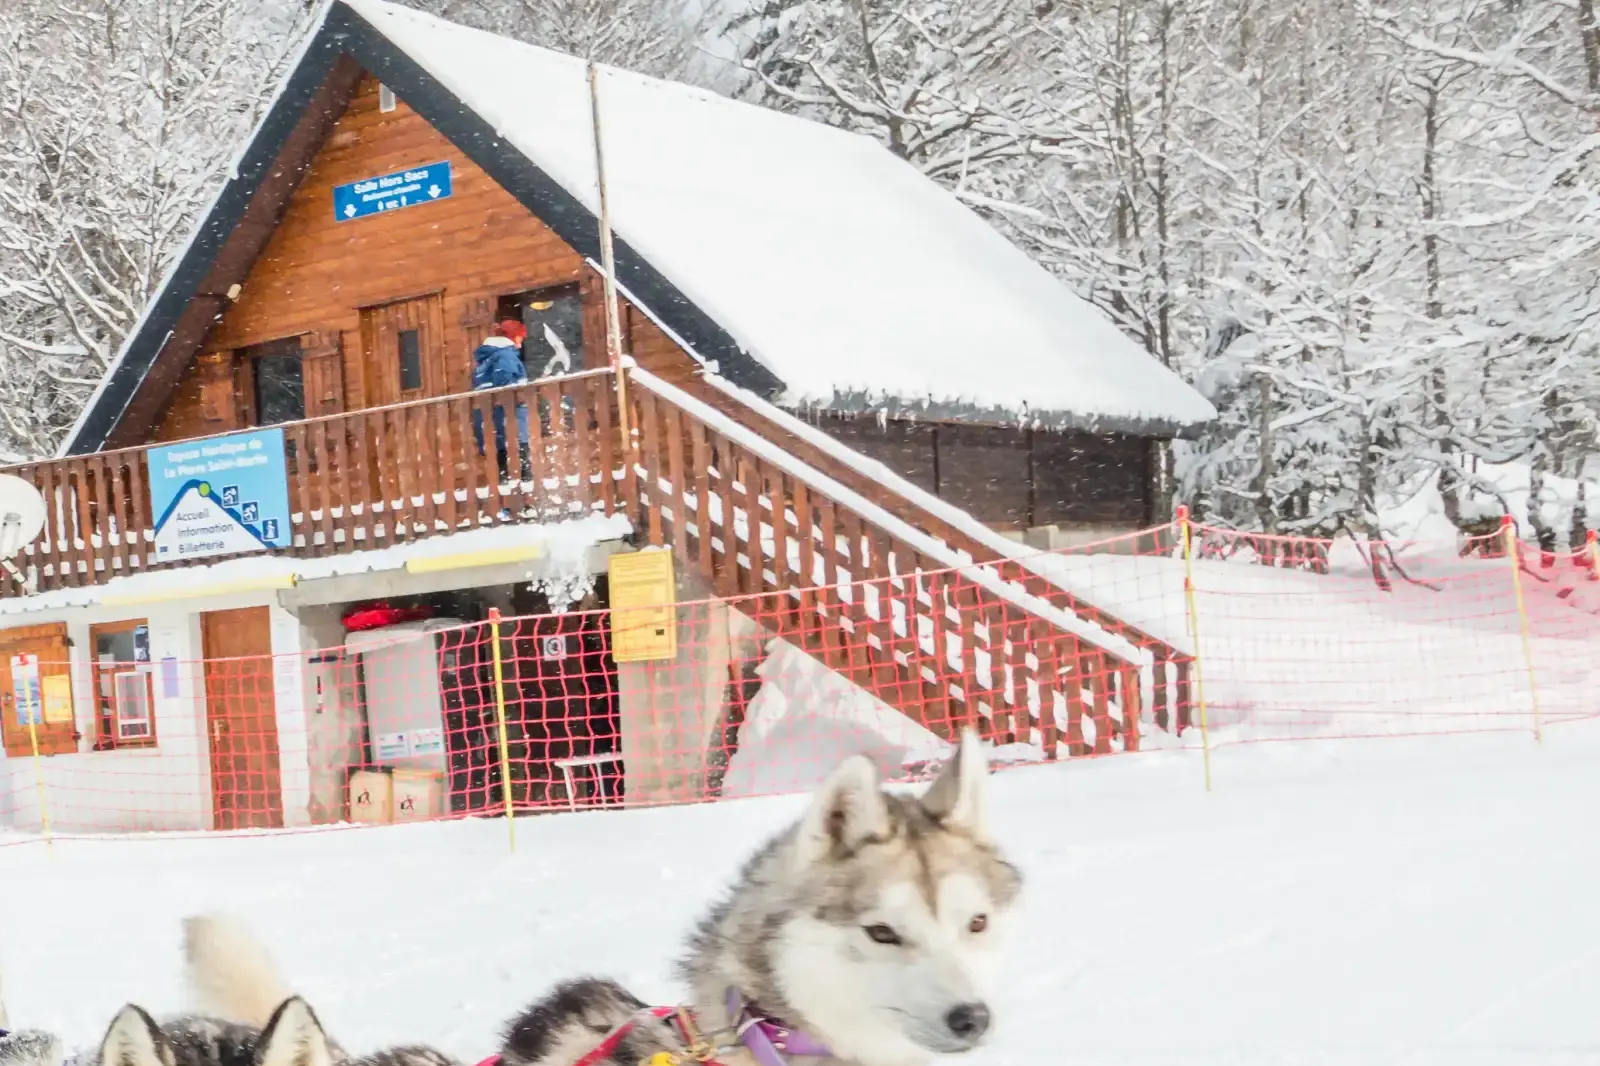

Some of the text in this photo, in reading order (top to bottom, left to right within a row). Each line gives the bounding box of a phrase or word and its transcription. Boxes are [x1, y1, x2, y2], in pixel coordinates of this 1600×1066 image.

[176, 508, 211, 521] Accueil
[177, 523, 234, 538] Information
[178, 540, 225, 554] Billetterie
